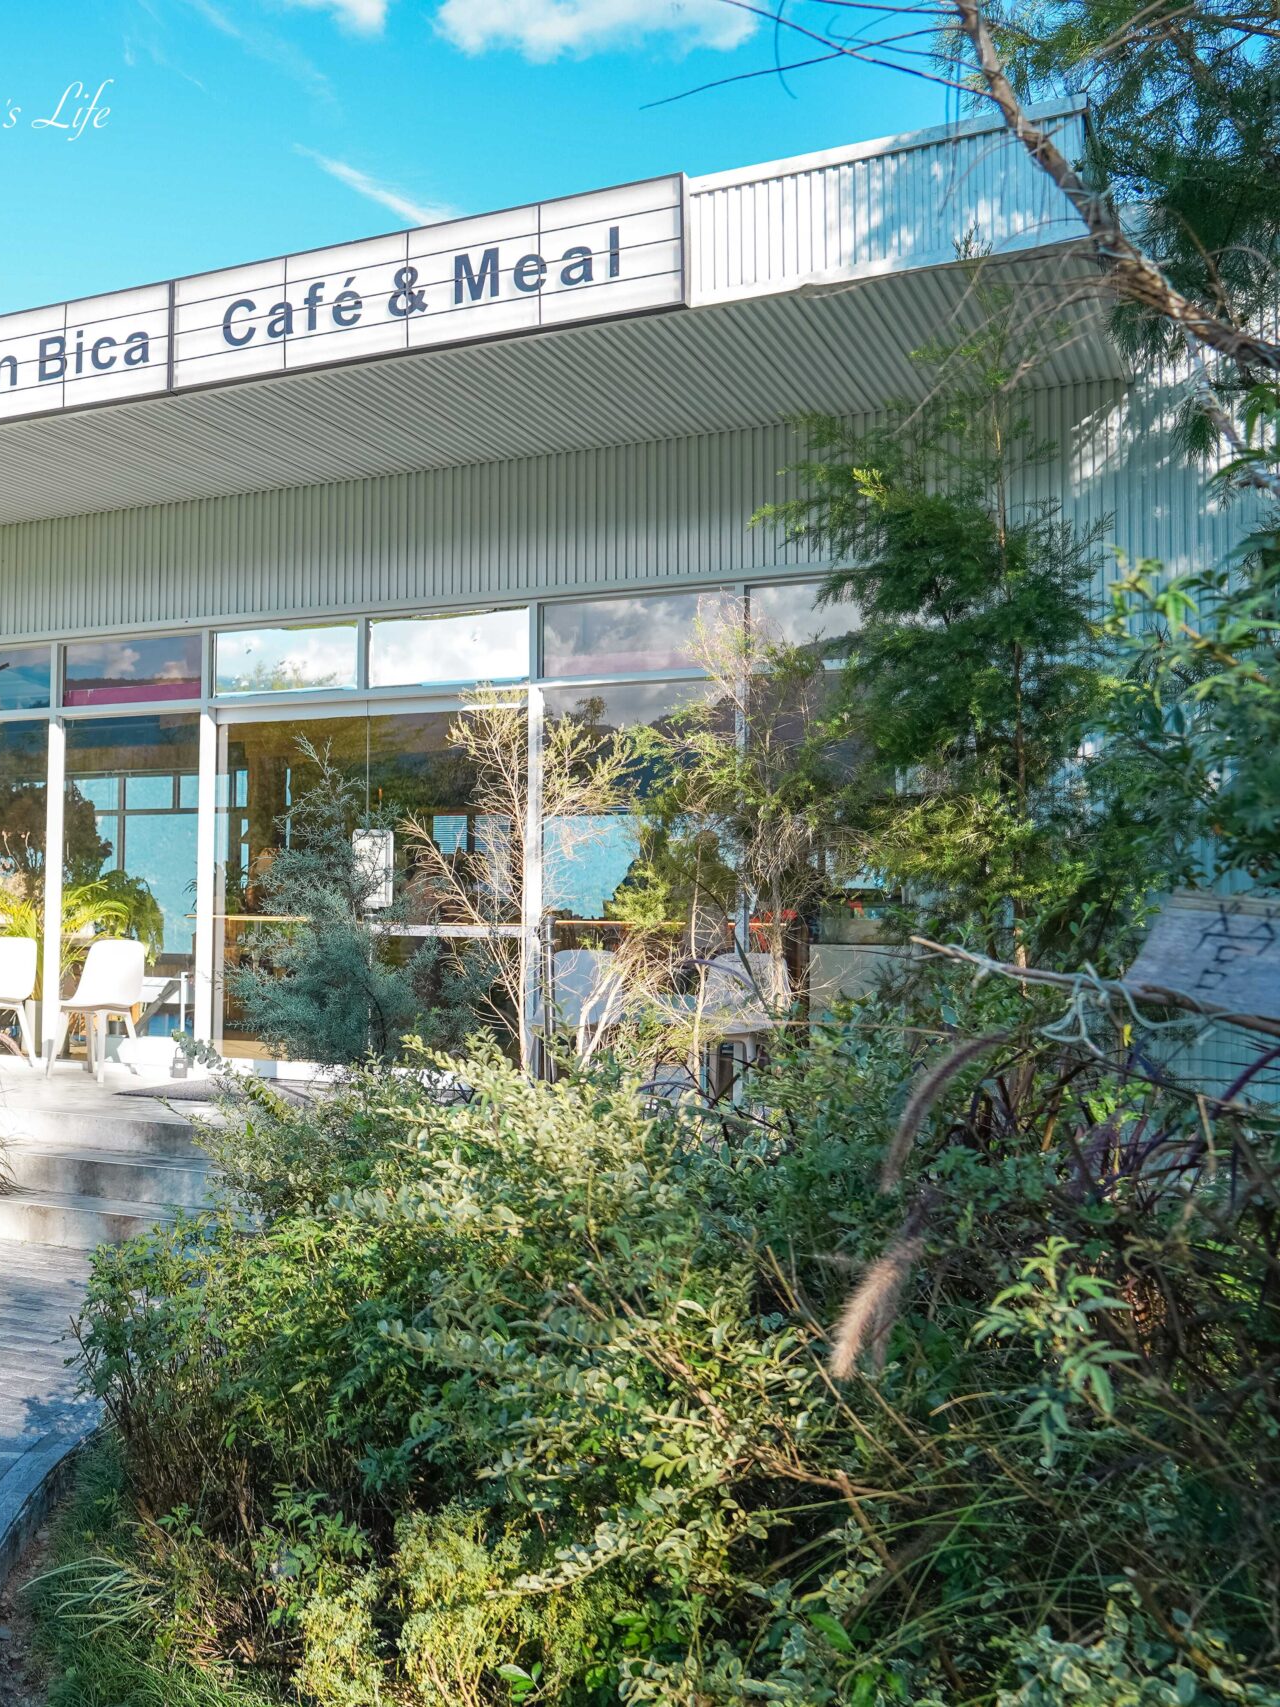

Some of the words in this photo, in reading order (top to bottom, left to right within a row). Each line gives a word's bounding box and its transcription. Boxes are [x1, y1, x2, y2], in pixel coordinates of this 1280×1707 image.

[38, 327, 151, 382] Bica
[223, 276, 363, 347] Café
[388, 266, 428, 317] &
[454, 226, 620, 305] Meal
